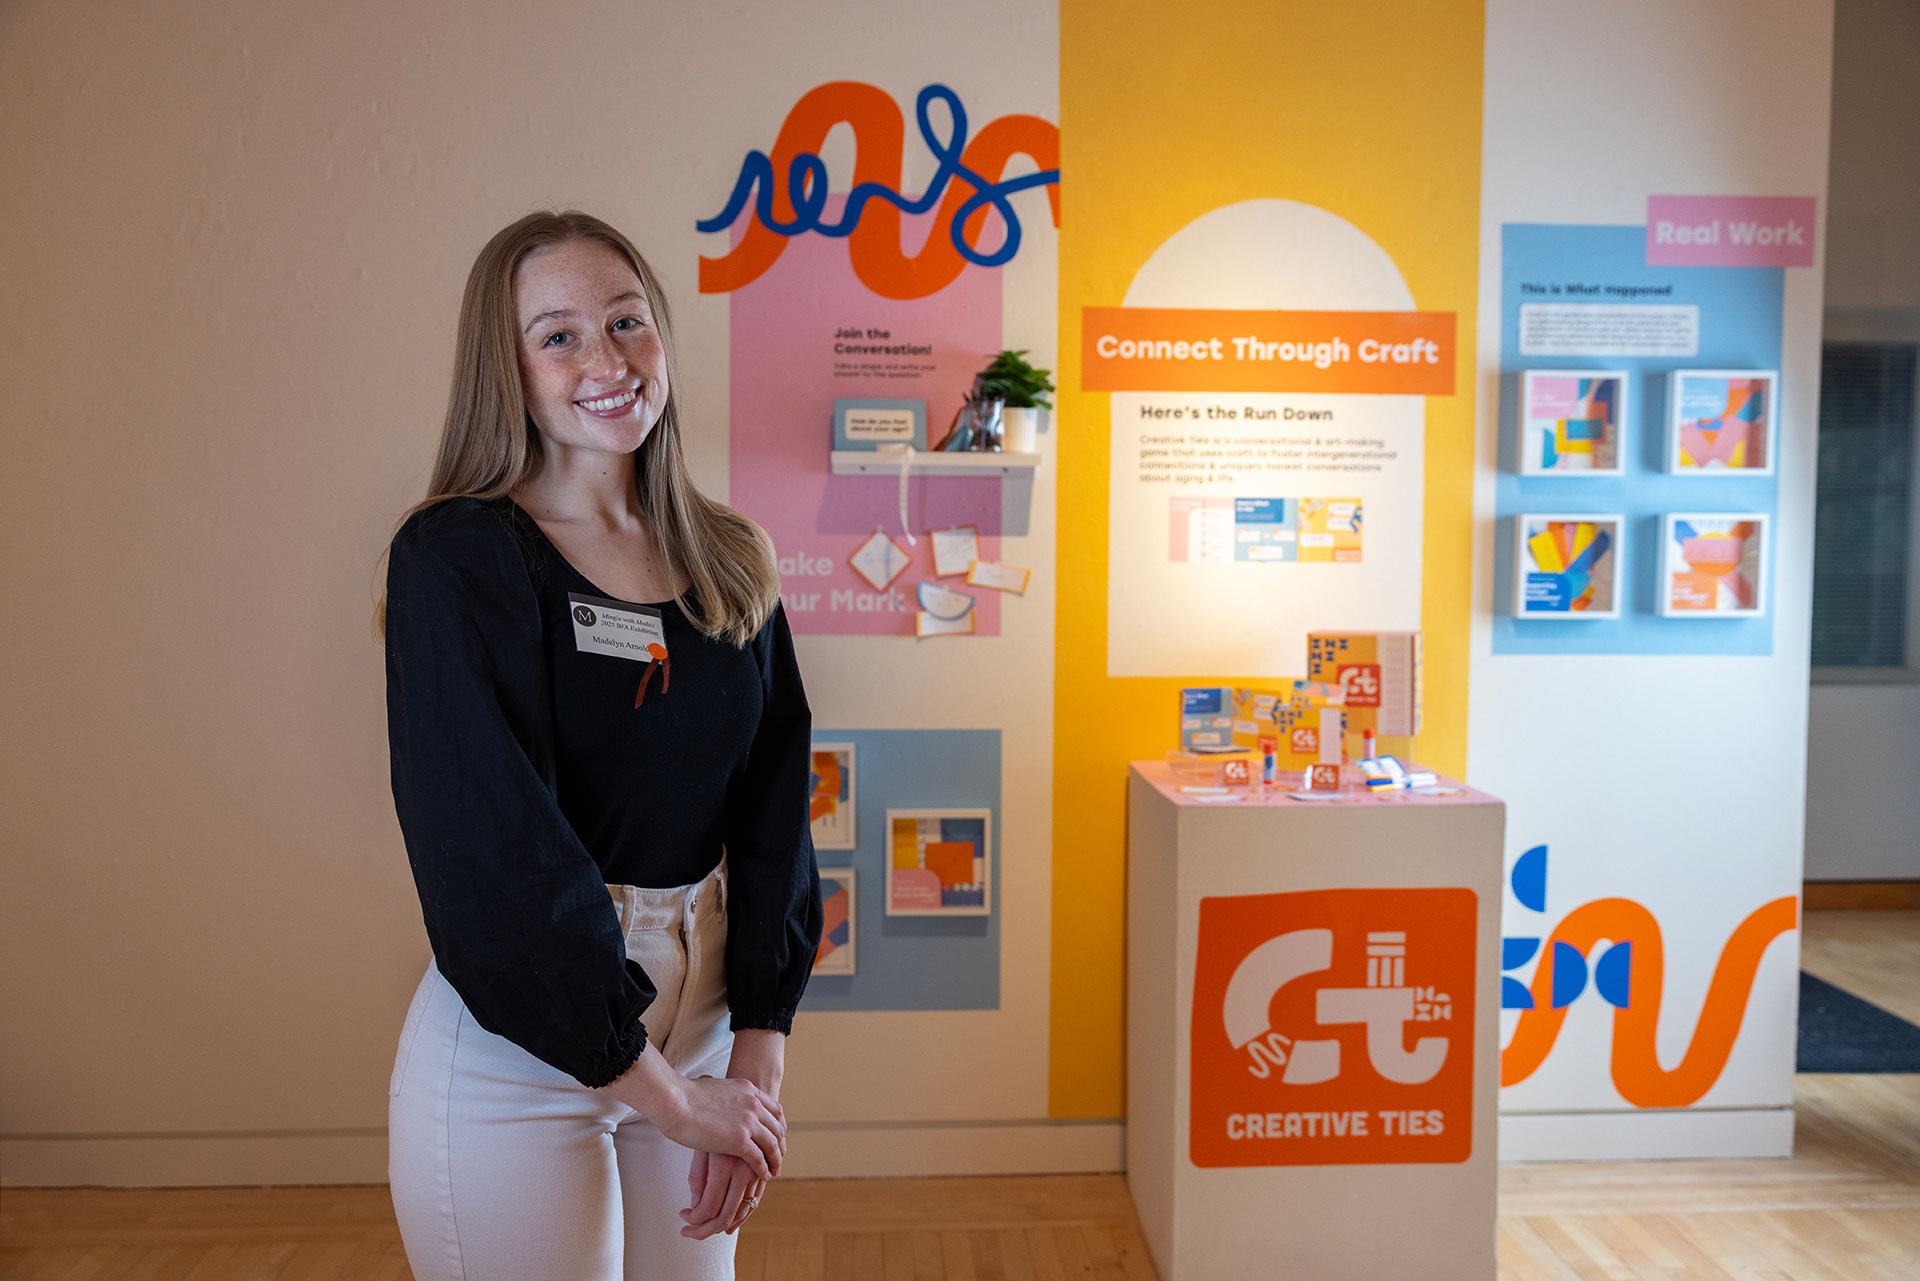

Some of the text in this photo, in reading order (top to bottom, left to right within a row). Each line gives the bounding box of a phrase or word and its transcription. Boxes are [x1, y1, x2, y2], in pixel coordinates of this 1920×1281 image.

[1656, 219, 1805, 247] Real Work
[1521, 283, 1672, 298] This is What Happened
[834, 327, 890, 339] Join the
[834, 342, 932, 355] Conversation!
[1096, 335, 1439, 369] Connect Through Craft
[1140, 405, 1333, 421] Here's the Run Down
[1139, 435, 1185, 445] Creative
[1188, 435, 1209, 445] Ties
[779, 551, 834, 576] ake
[831, 588, 905, 612] Mark
[577, 609, 593, 623] M
[616, 623, 629, 631] BFA
[592, 635, 625, 649] Madelyn
[1226, 1109, 1445, 1140] CREATIVE TIES
